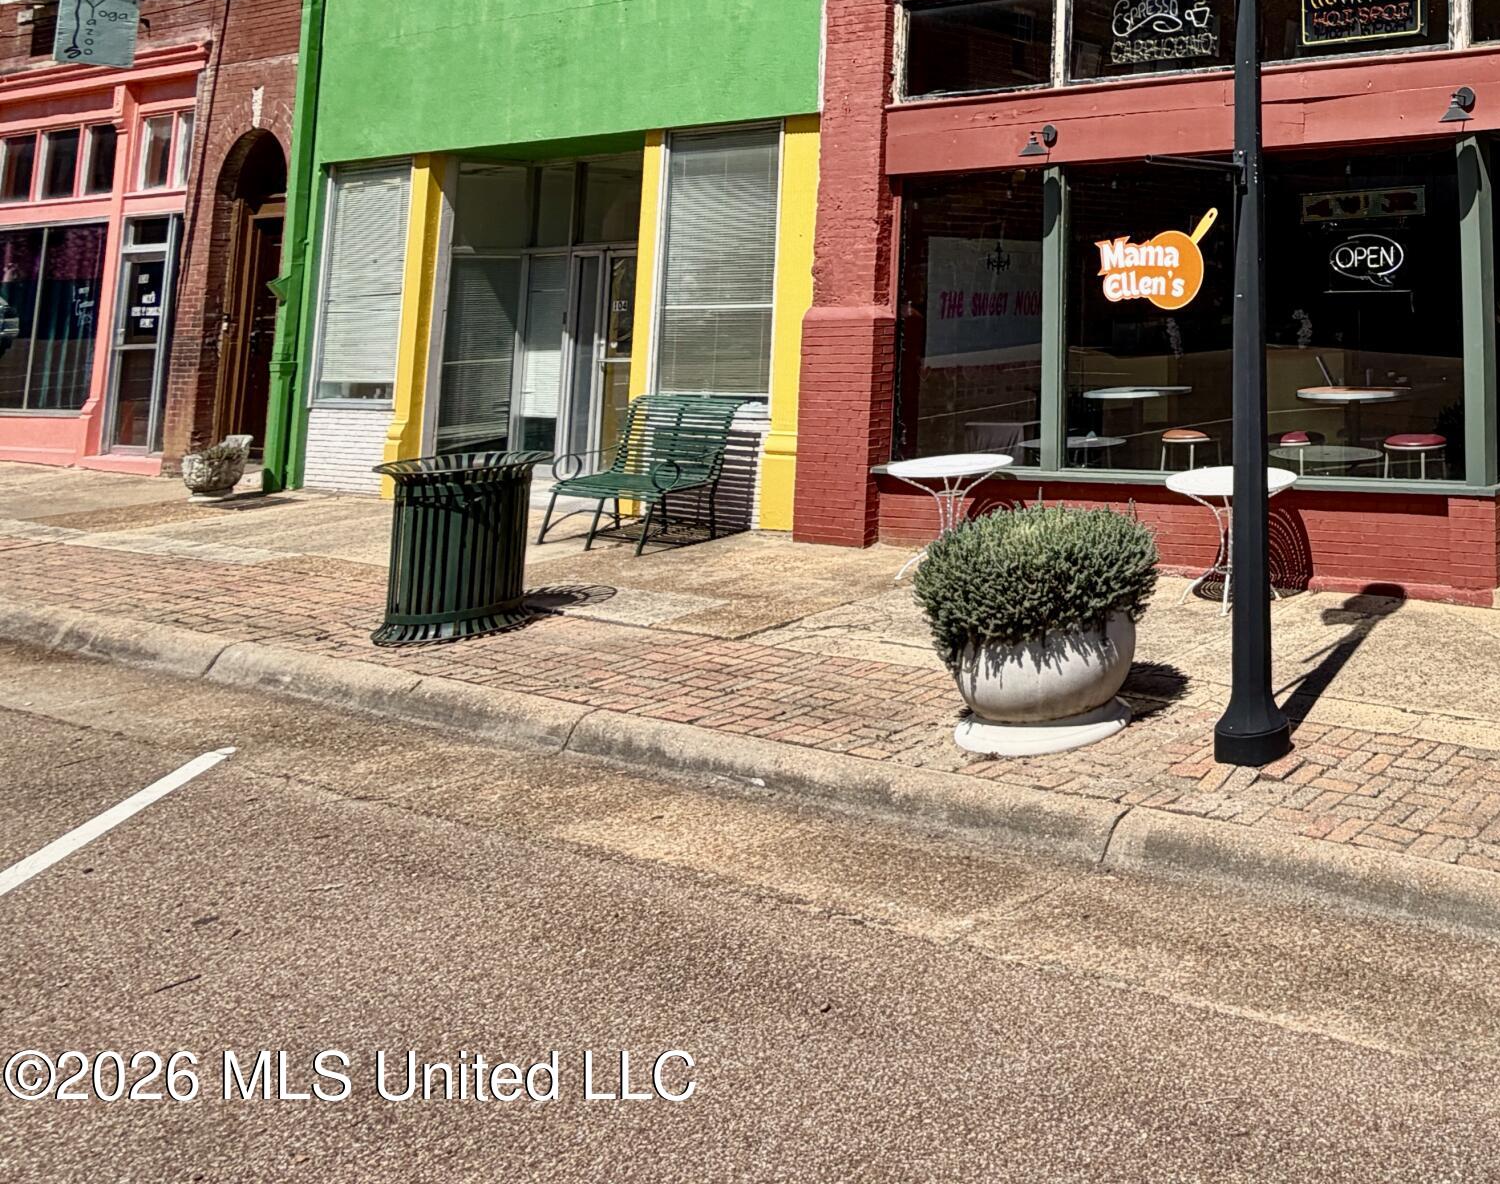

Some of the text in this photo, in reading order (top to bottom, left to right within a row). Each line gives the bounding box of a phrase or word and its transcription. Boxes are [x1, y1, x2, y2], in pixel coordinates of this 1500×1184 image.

[1101, 241, 1180, 272] Mama
[1335, 246, 1395, 269] OPEN
[1104, 270, 1185, 300] Ellen's
[939, 290, 965, 320] THE
[971, 291, 1008, 317] SWEET
